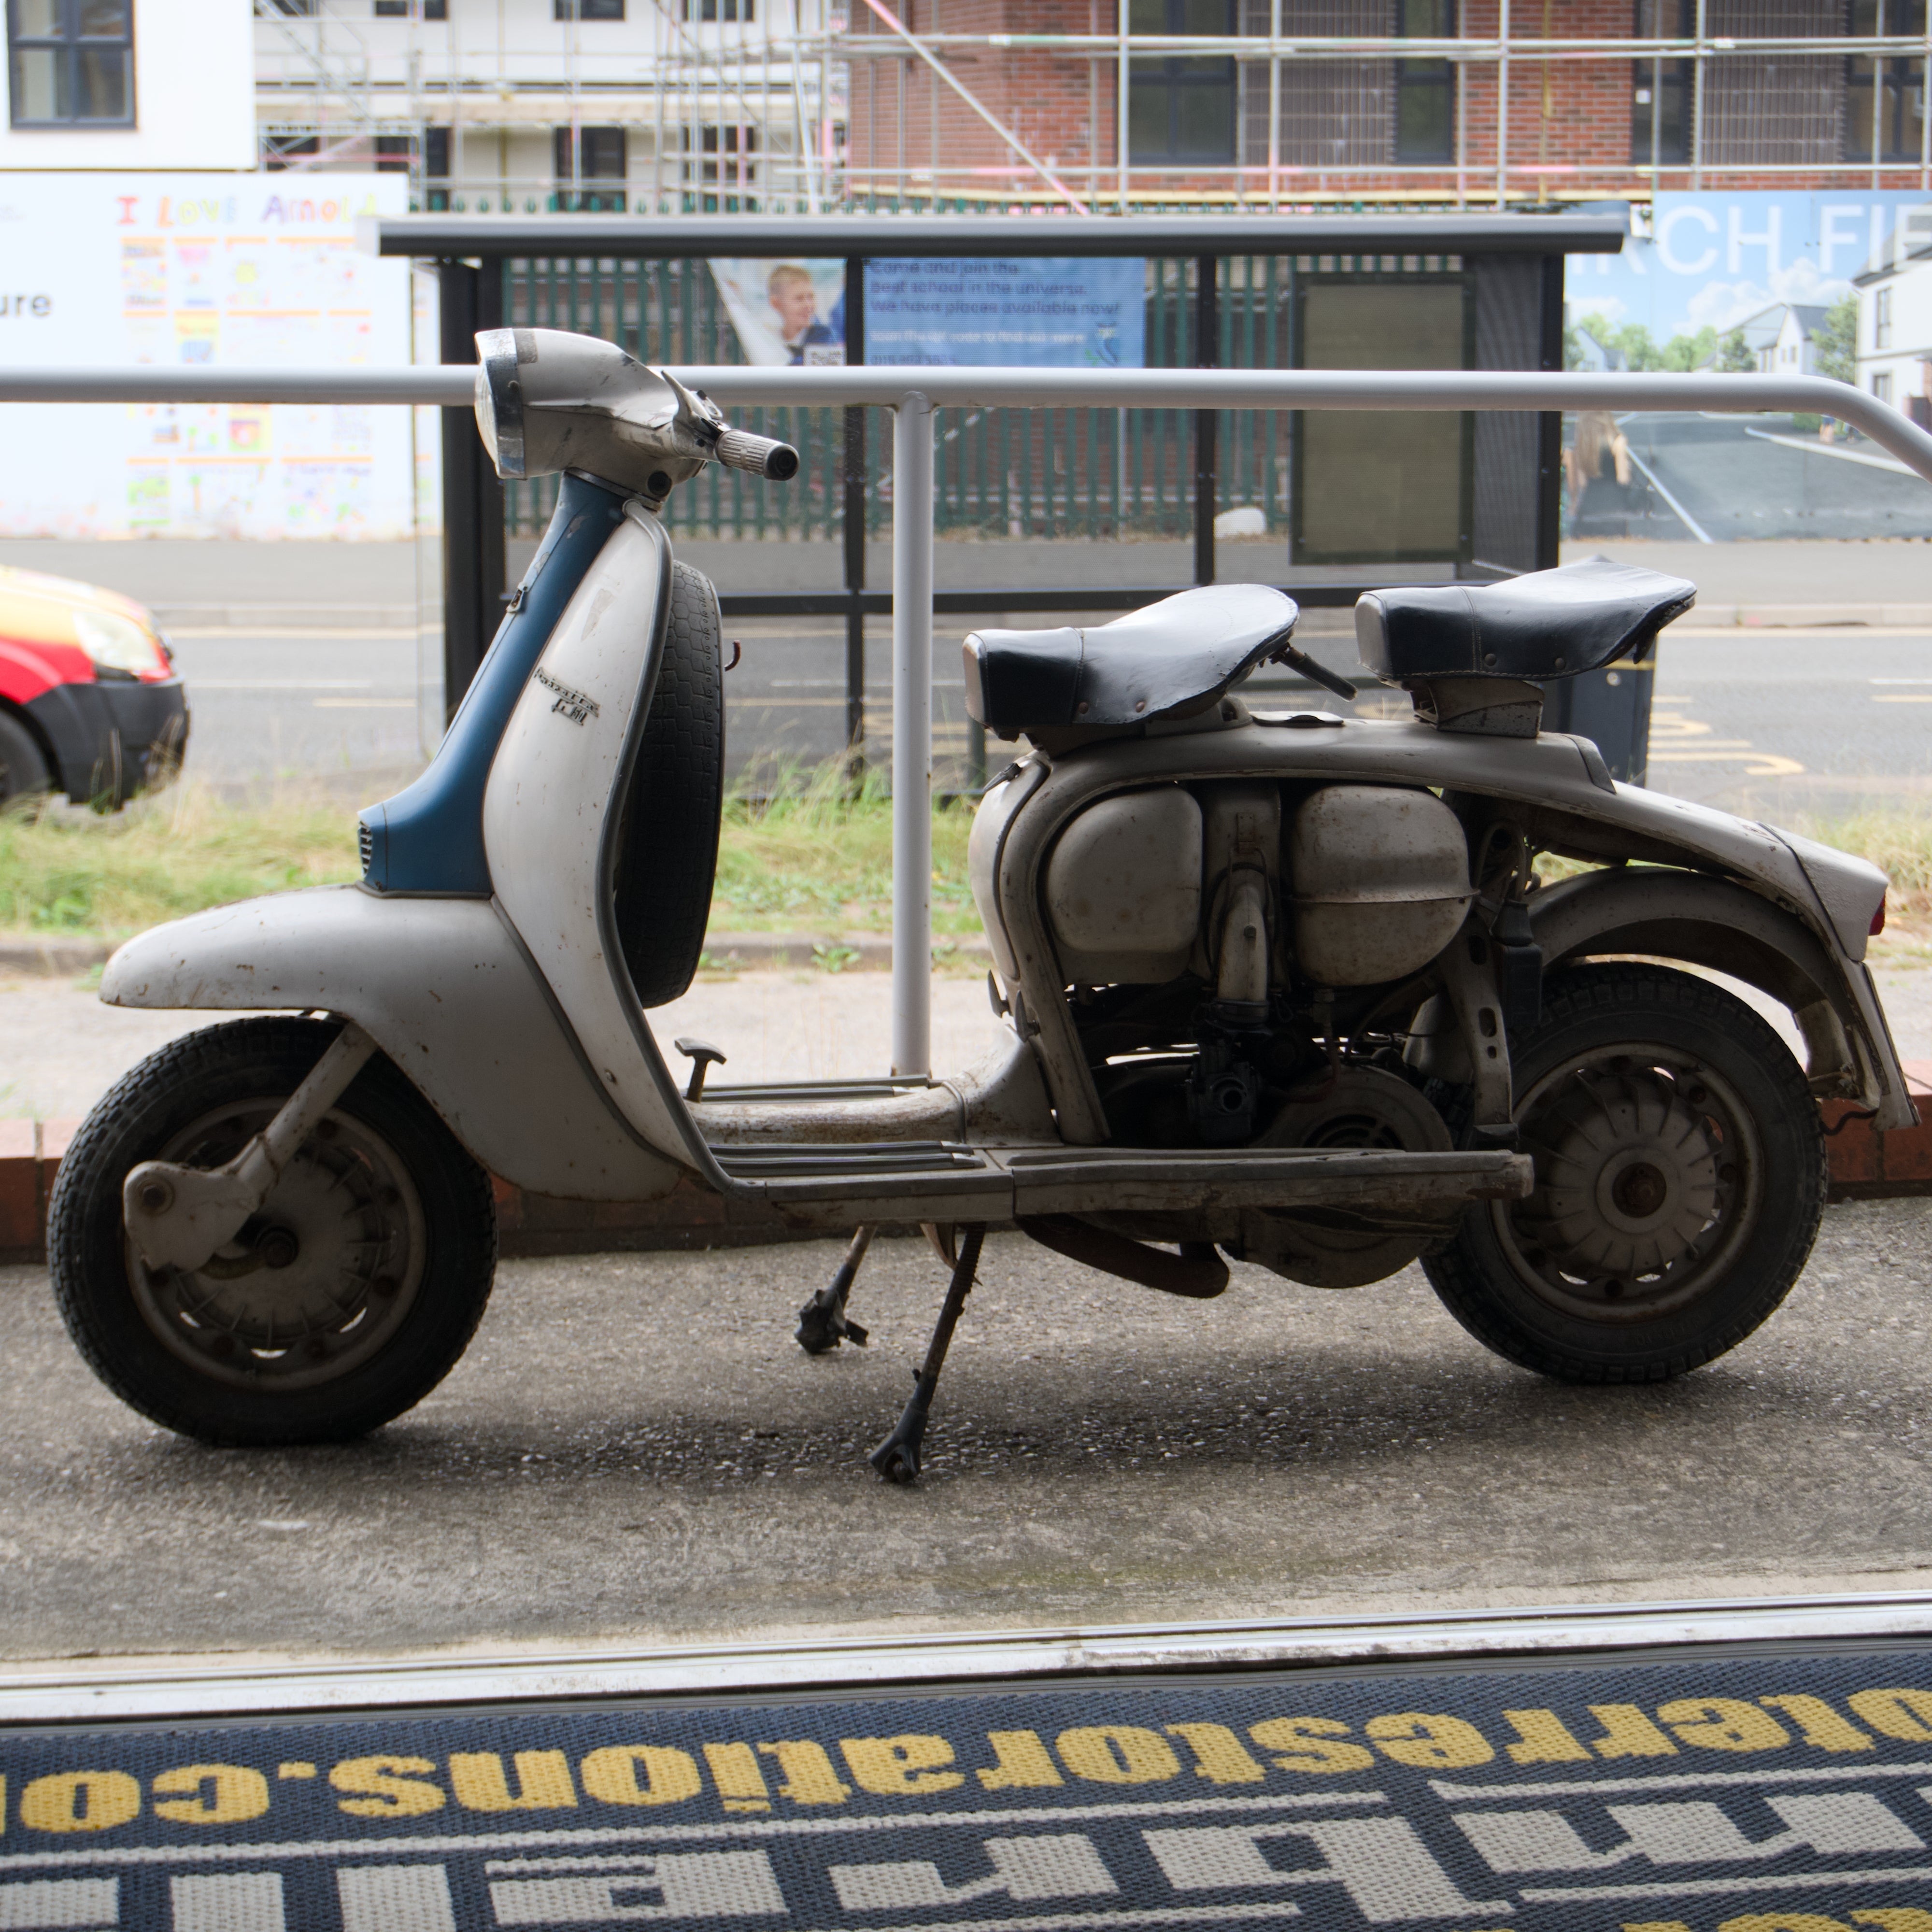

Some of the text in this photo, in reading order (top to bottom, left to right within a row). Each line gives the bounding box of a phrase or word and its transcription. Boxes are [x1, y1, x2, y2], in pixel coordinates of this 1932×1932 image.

[116, 197, 139, 225] I
[924, 262, 955, 274] and
[960, 262, 988, 277] join
[993, 262, 1019, 274] the
[911, 282, 963, 294] school
[968, 283, 982, 294] in
[987, 283, 1011, 295] the
[871, 301, 896, 313] We
[900, 301, 941, 313] have
[945, 302, 998, 316] places
[1002, 302, 1076, 314] available
[0, 1688, 1932, 1834] oterrestorations.co
